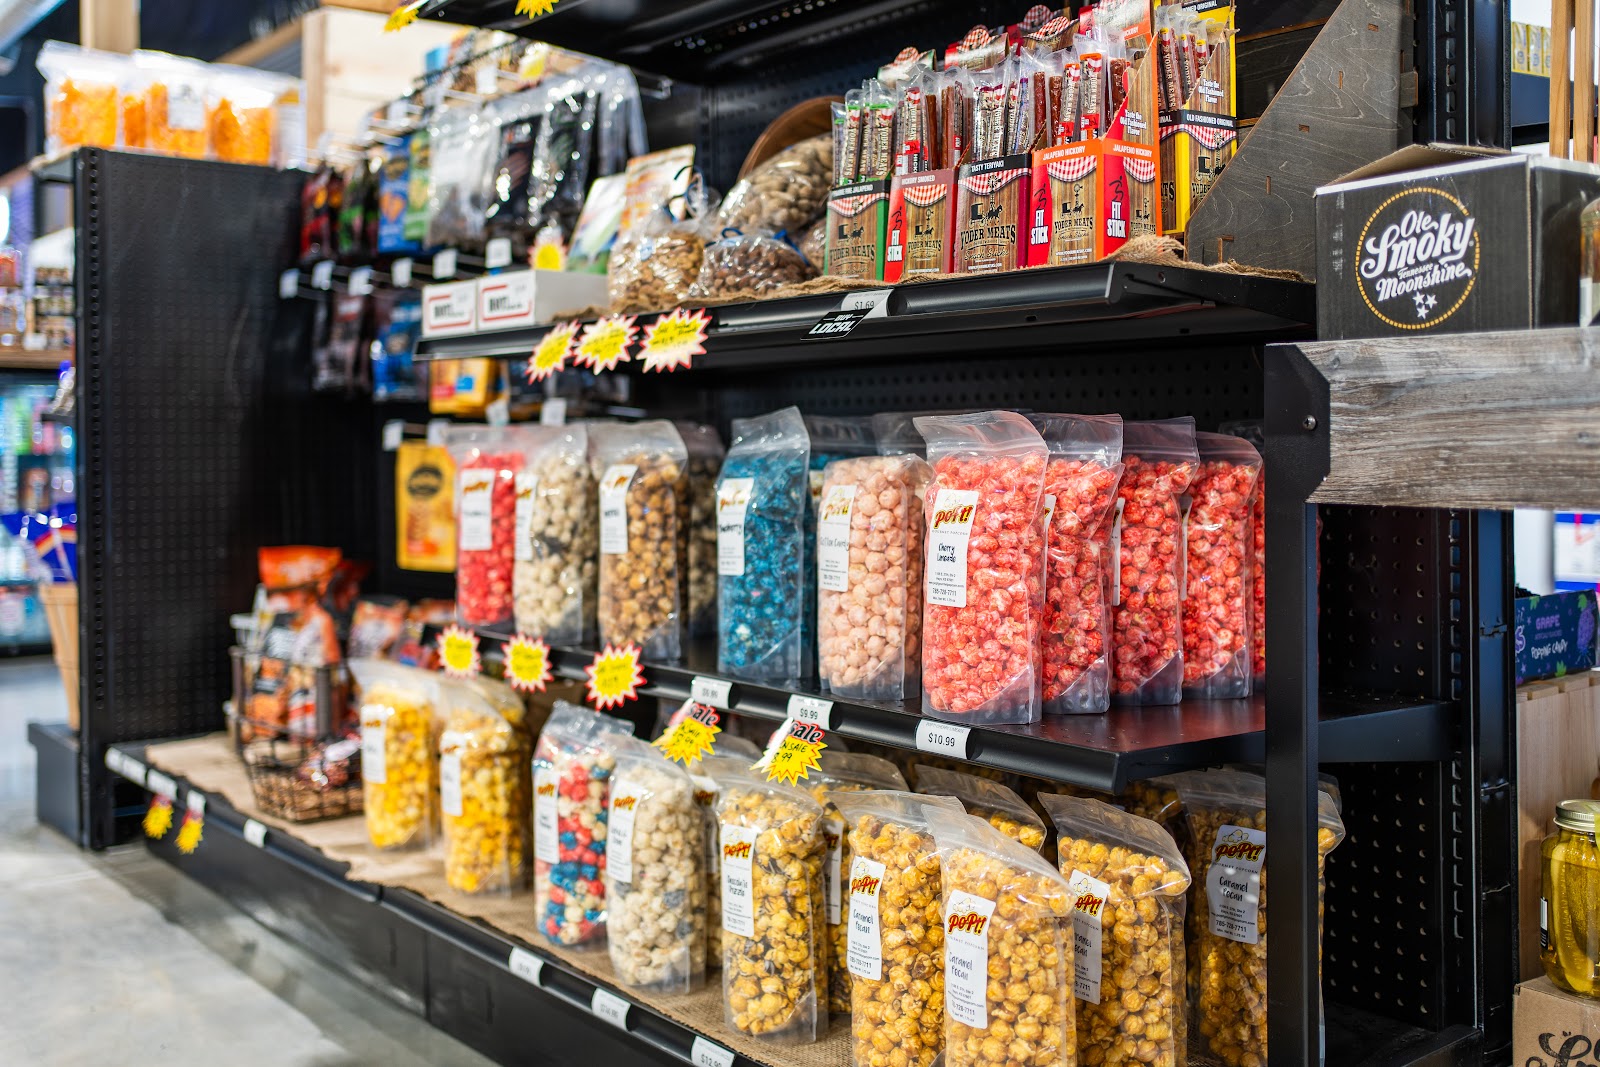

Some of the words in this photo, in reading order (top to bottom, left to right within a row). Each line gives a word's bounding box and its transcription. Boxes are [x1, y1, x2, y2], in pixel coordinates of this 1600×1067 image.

[1042, 149, 1065, 160] JALAPENO
[1064, 145, 1086, 156] HICKORY
[1113, 144, 1136, 154] JALAPENO
[1136, 148, 1152, 158] HICKORY
[971, 164, 984, 173] TASTY
[1112, 200, 1122, 219] FIT
[1036, 209, 1044, 227] FIT
[1400, 210, 1438, 238] Ole
[1031, 226, 1049, 244] STICK
[1107, 218, 1126, 238] STICK
[961, 229, 985, 250] YODER
[986, 224, 1016, 244] MEATS
[1361, 213, 1475, 278] Smoky
[1398, 262, 1433, 280] Tennessee
[1376, 260, 1472, 302] Moonshine
[854, 300, 875, 310] $169
[809, 320, 856, 334] LOCAL
[938, 543, 955, 556] Cherry
[1536, 614, 1560, 630] GRAPE
[1551, 638, 1569, 654] CANDY
[800, 707, 818, 720] $9.99
[788, 742, 808, 753] SALE
[928, 732, 956, 747] $10.99
[1236, 866, 1258, 874] POPCORN
[1219, 876, 1248, 893] Caramel
[1223, 888, 1243, 902] Pecan
[949, 951, 973, 971] Caramel
[951, 966, 969, 981] Pecan
